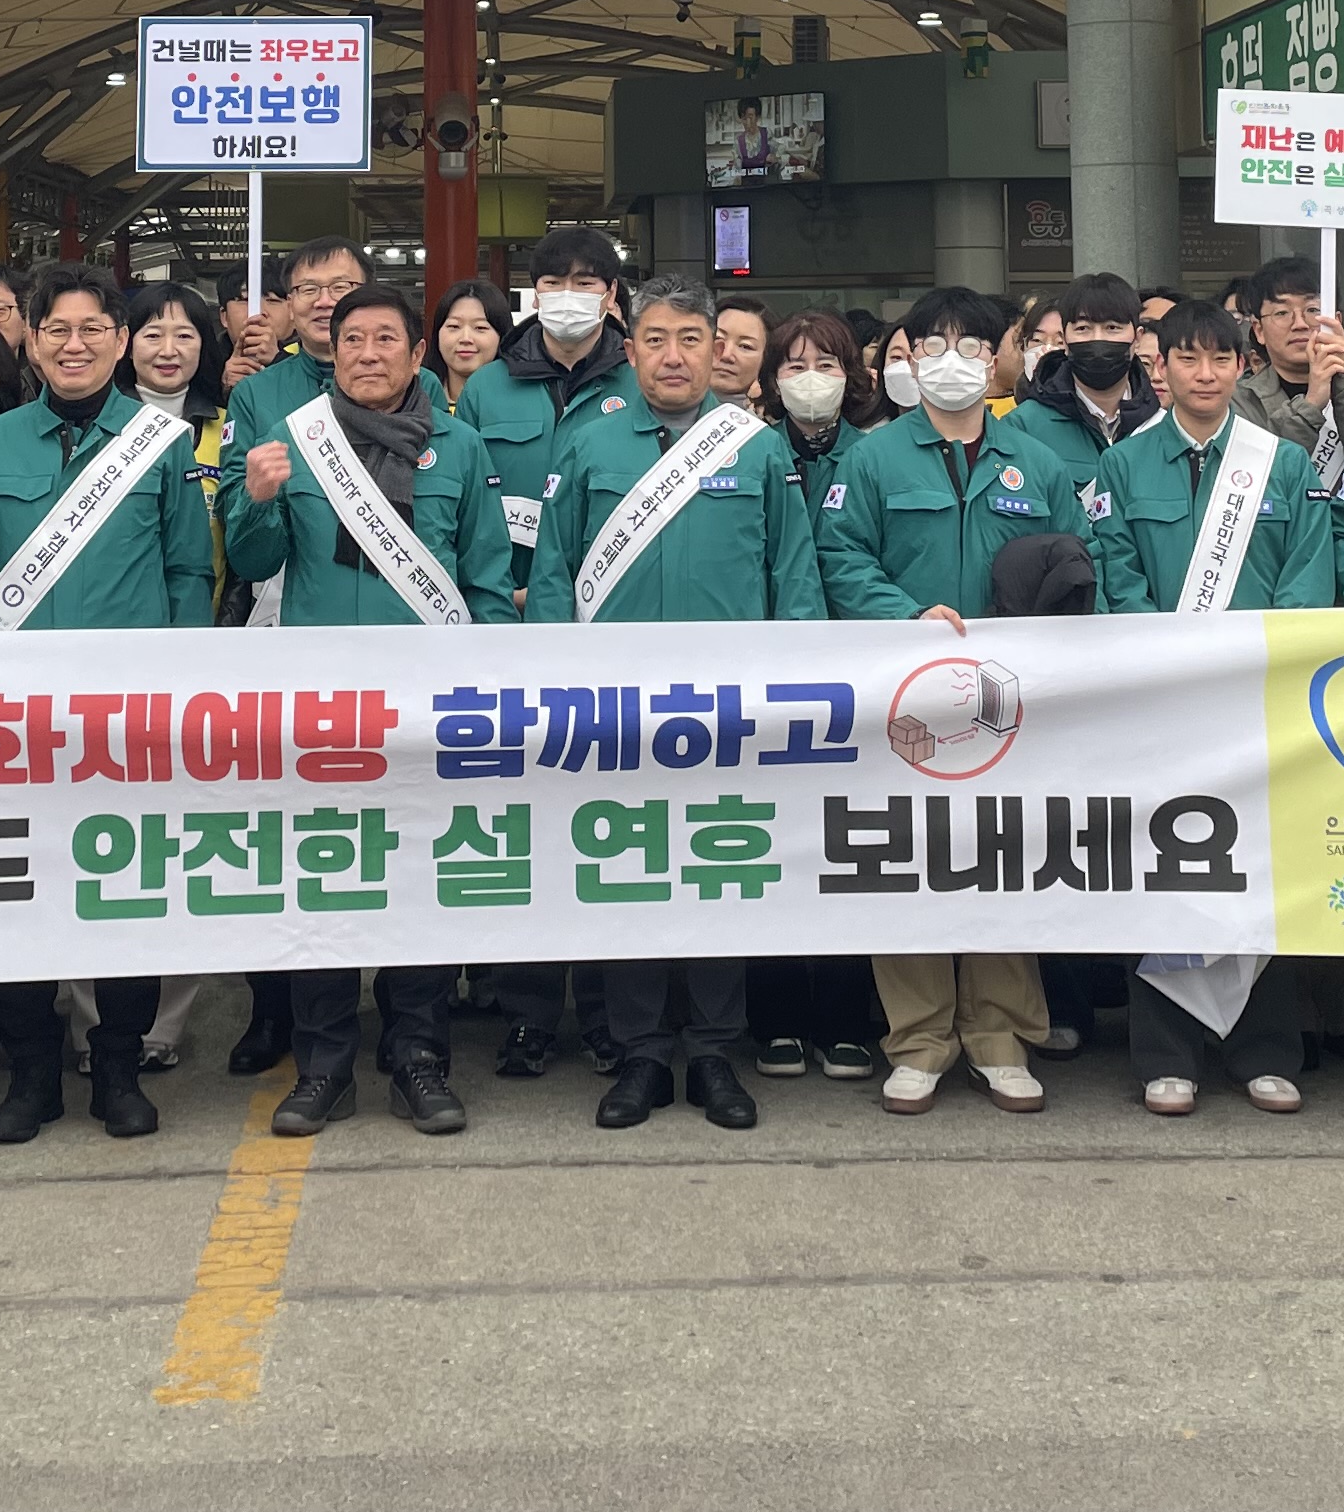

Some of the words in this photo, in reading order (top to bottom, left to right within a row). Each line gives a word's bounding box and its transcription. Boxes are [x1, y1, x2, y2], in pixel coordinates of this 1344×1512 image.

[152, 38, 253, 63] 건널때는
[259, 38, 360, 63] 좌우보고
[171, 85, 341, 125] 안전보행
[212, 135, 297, 159] 하세요!
[1241, 124, 1316, 152] 재난은
[1240, 158, 1315, 185] 안전은
[119, 413, 172, 467] 대한민국
[683, 419, 737, 472] 대한민국
[63, 464, 123, 533] 안전하자
[318, 437, 362, 501] 대한민국
[356, 500, 414, 568] 안전하자
[407, 565, 449, 614] 캠페인
[627, 470, 686, 532] 안전하자
[592, 528, 631, 582] 캠페인
[1210, 493, 1245, 567] 대한민국
[21, 530, 69, 586] 캠페인
[430, 681, 861, 780] 함께하고
[71, 806, 400, 922] 안전한
[432, 801, 533, 908] 설
[570, 793, 783, 903] 연휴
[818, 793, 1249, 894] 보내세요
